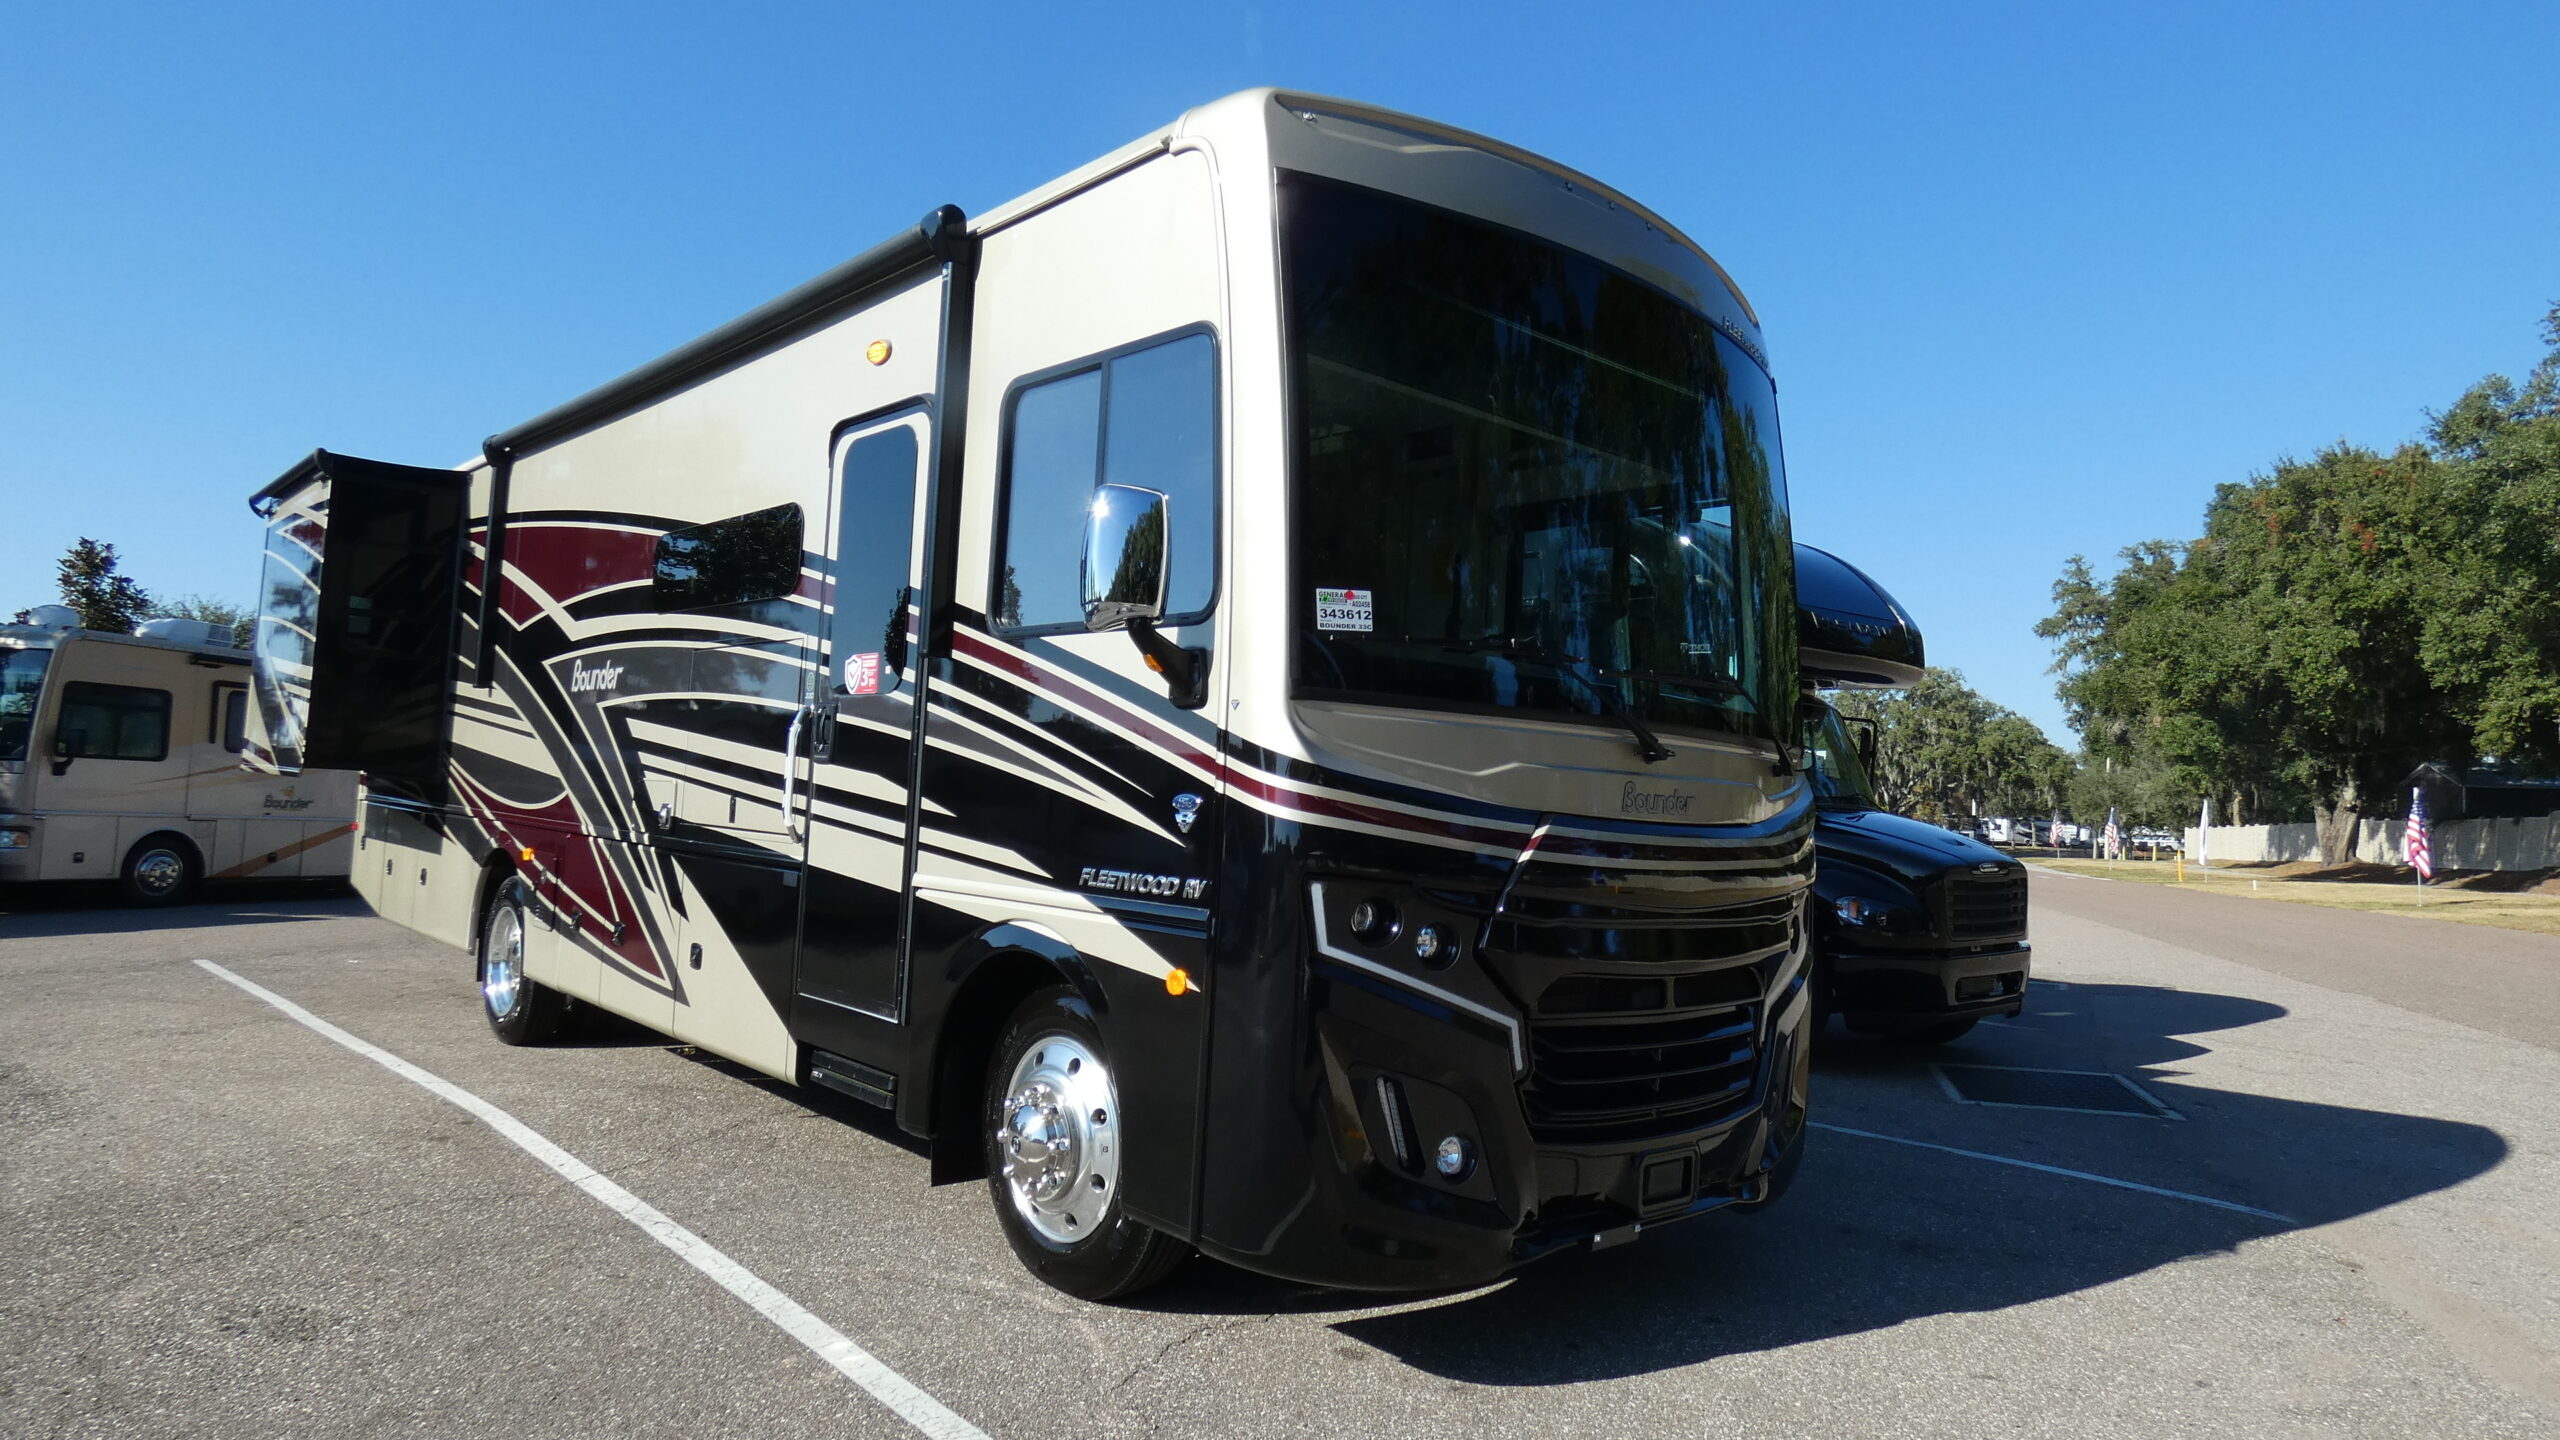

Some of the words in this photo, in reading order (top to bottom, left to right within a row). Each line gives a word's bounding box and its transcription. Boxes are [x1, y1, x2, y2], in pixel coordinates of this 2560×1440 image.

[1320, 608, 1372, 620] 343612
[571, 659, 624, 692] Bounder
[263, 794, 313, 809] Bounder
[1621, 780, 1696, 815] Bounder
[1079, 867, 1180, 897] FLEETWOOD
[1182, 878, 1208, 900] RV
